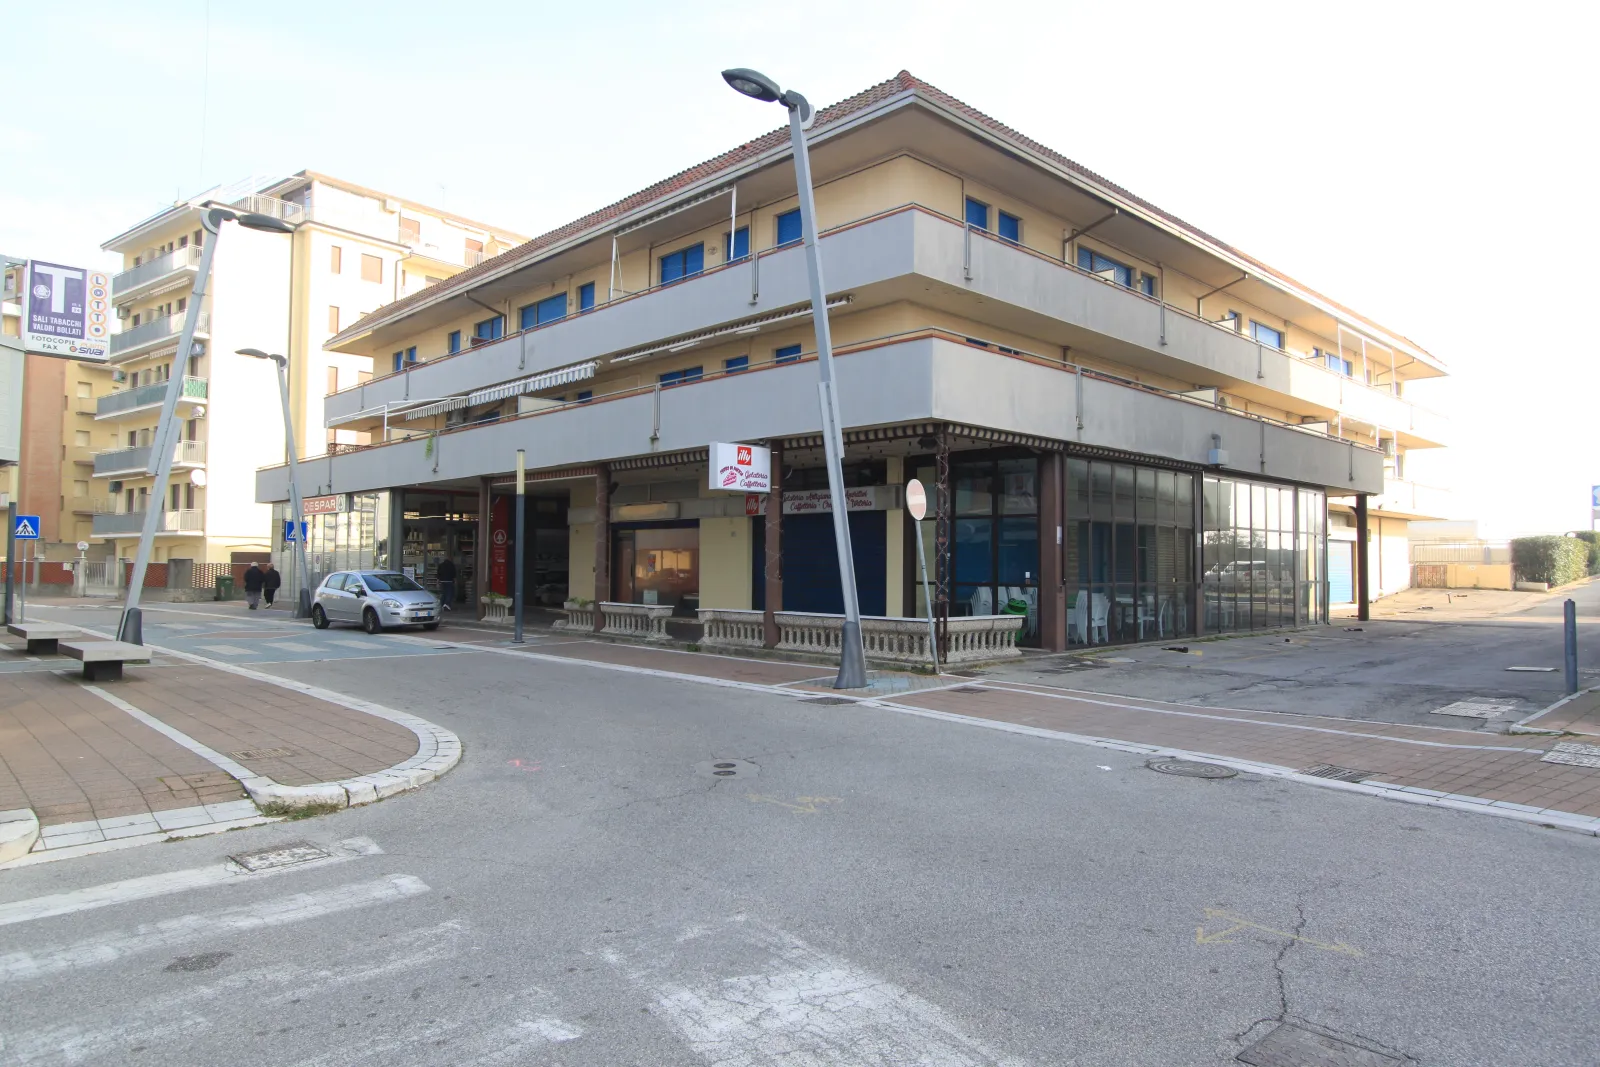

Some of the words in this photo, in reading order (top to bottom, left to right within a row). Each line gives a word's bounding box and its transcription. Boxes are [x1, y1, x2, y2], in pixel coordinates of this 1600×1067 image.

[34, 264, 83, 314] T
[92, 275, 105, 334] LOTTO
[33, 314, 48, 323] SALI
[50, 316, 82, 328] TABACCHI
[32, 323, 55, 333] VALORI
[56, 325, 82, 336] BOLLATI
[31, 335, 76, 346] FOTOCOPIE
[738, 449, 751, 464] illy
[744, 470, 768, 479] Gelateria
[739, 479, 767, 488] Caffetteria
[746, 498, 758, 513] illy
